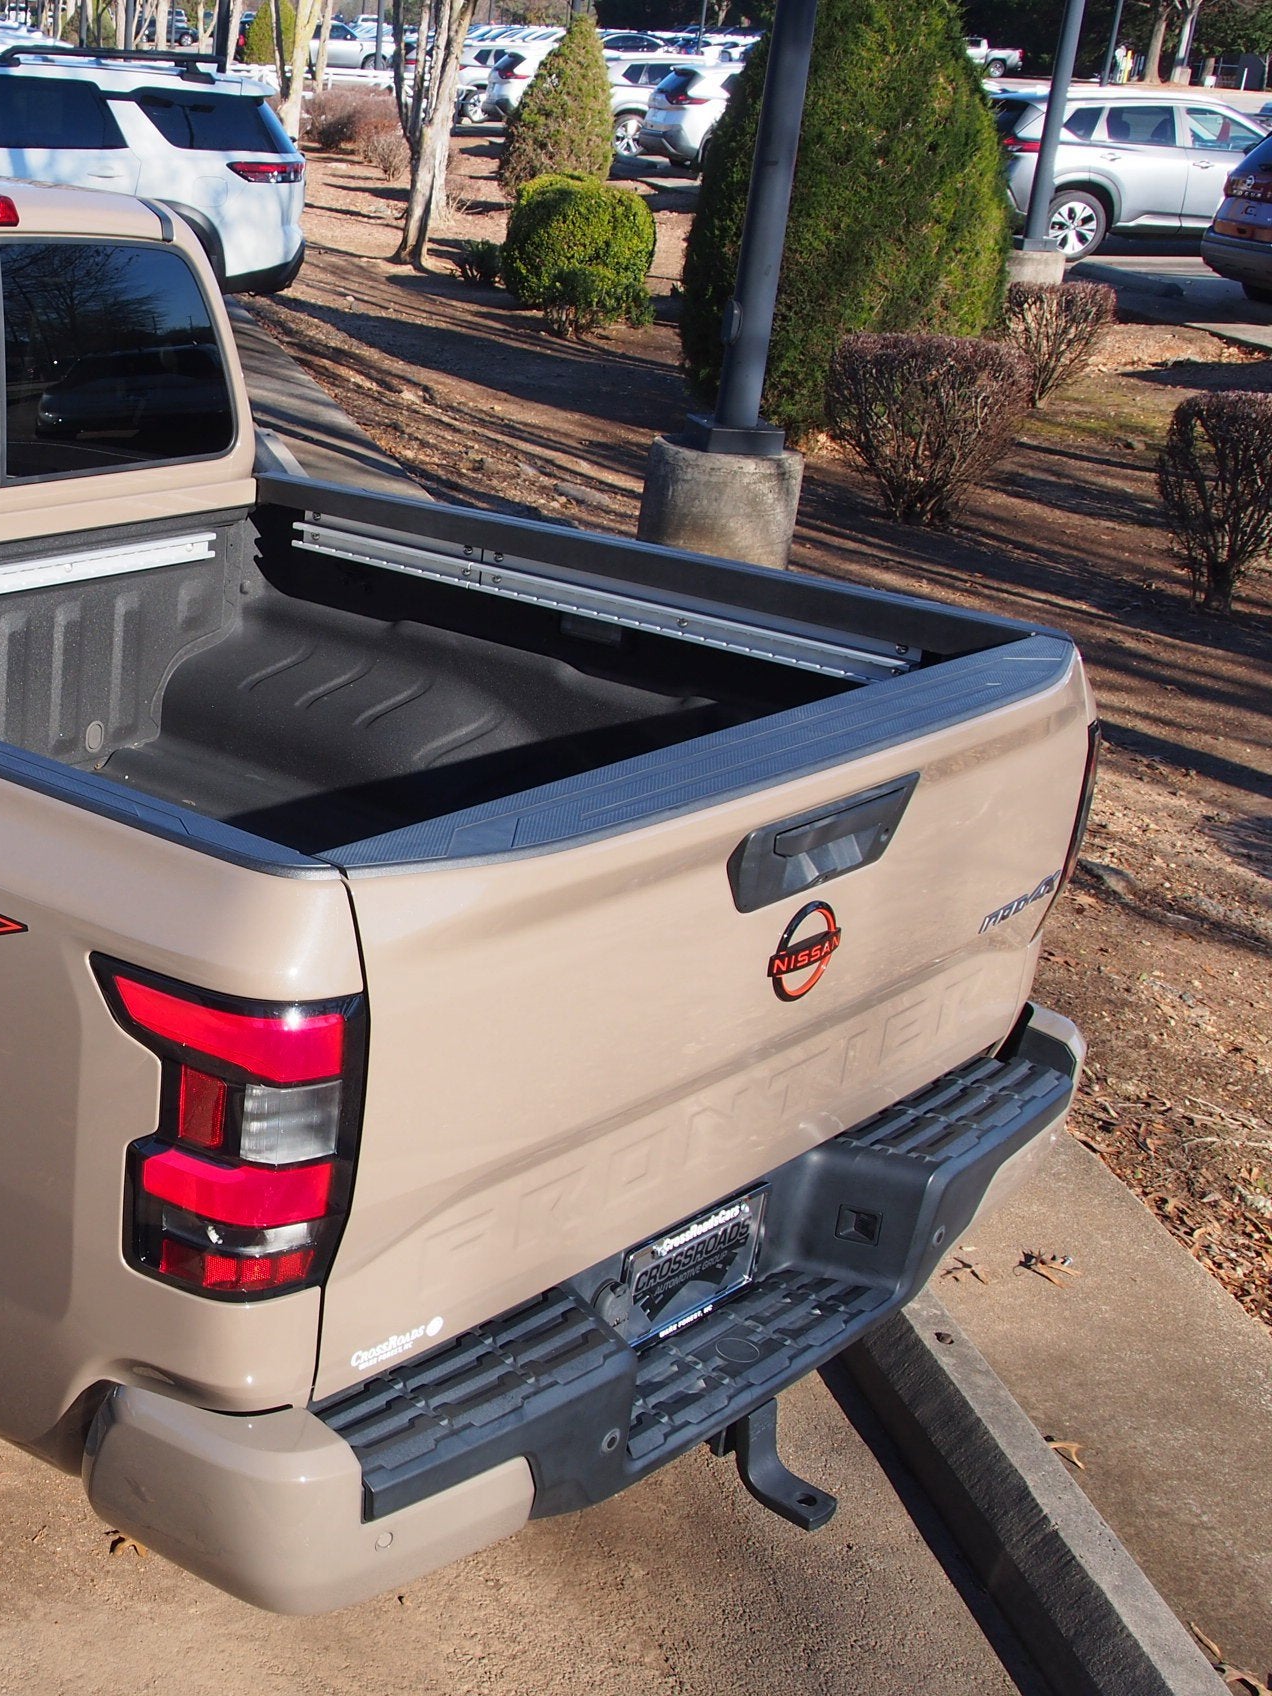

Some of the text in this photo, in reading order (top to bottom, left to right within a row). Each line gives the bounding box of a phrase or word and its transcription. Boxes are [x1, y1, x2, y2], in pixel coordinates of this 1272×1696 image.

[772, 932, 841, 975] NISSAN
[420, 968, 984, 1278] FRONTIER
[633, 1217, 751, 1294] CROSSROADS
[654, 1250, 728, 1296] AUTOMOTIVE GROUP
